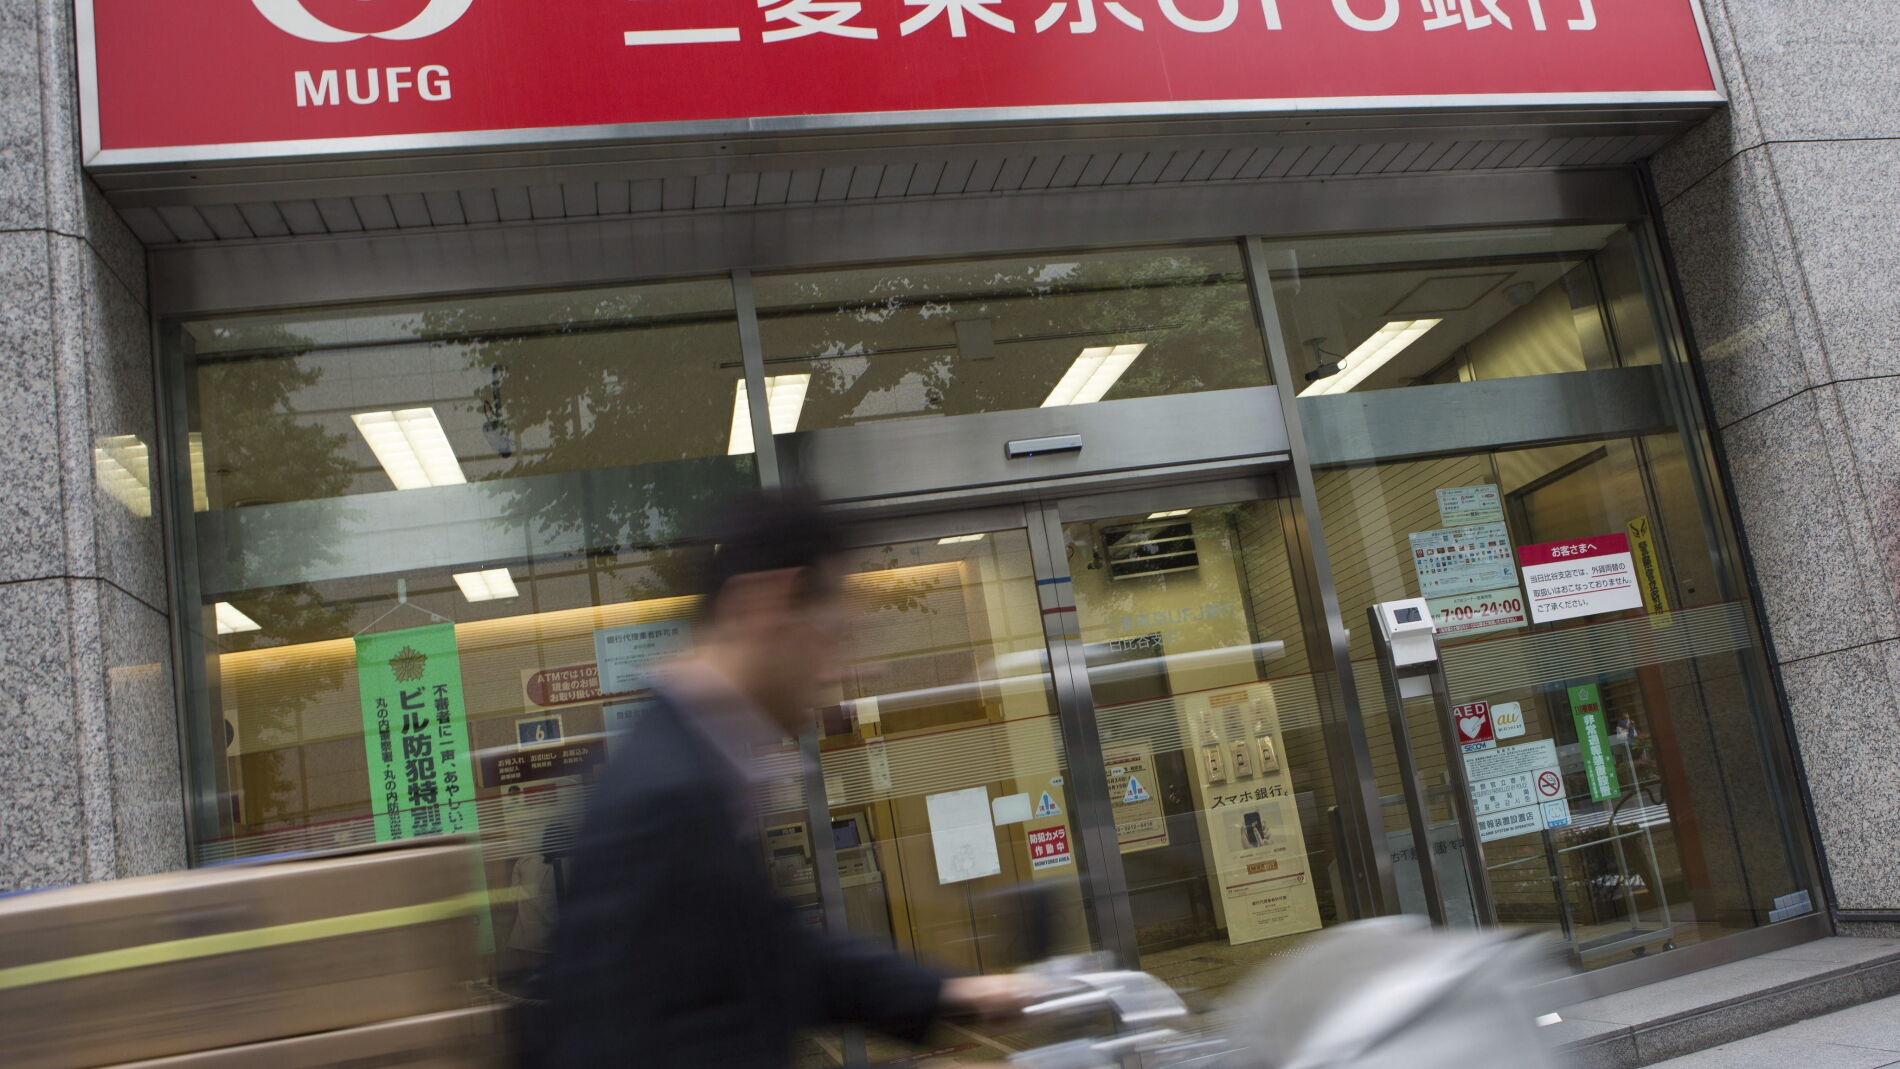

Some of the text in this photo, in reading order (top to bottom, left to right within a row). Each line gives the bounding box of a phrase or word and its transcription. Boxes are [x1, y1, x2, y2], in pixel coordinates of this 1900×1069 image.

[295, 64, 452, 108] MUFG
[1551, 543, 1597, 558] お客さまへ
[1453, 703, 1485, 718] AED
[1497, 712, 1519, 726] au
[535, 724, 545, 741] 6
[1464, 742, 1487, 752] SECOM
[1029, 828, 1066, 845] 防犯カメラ
